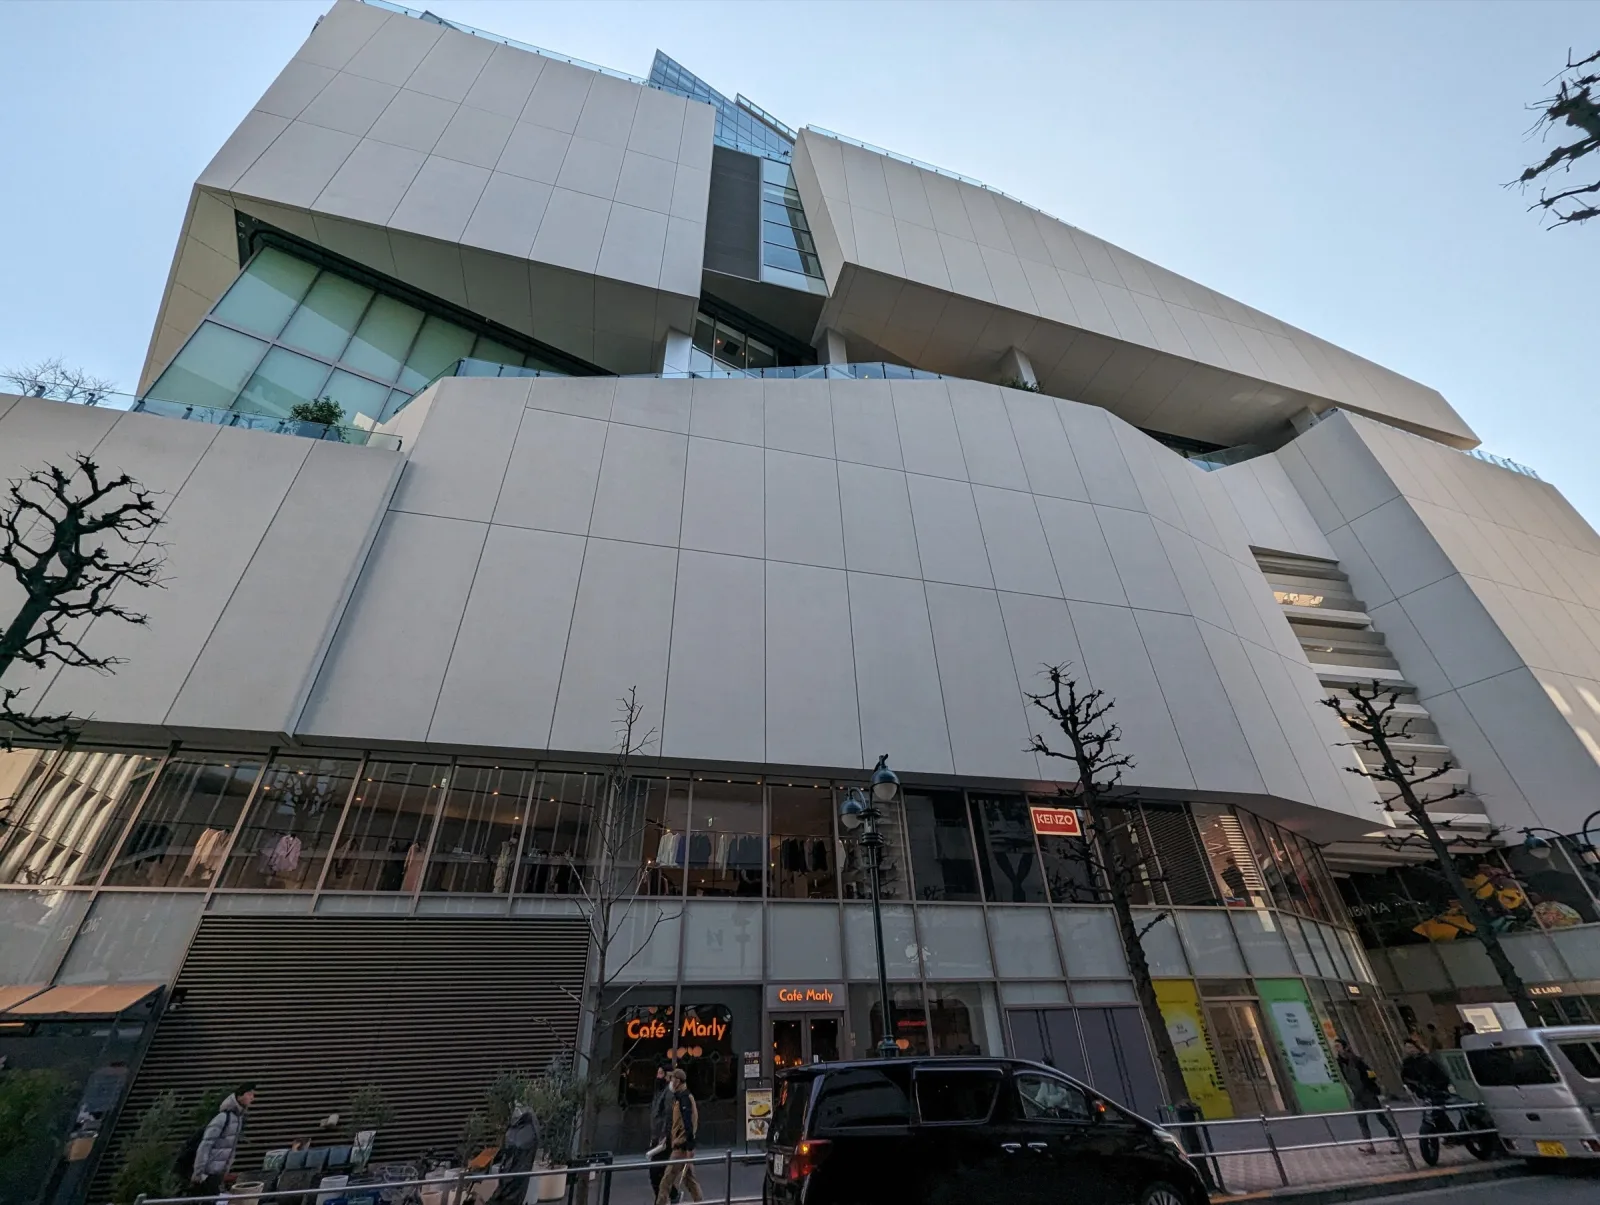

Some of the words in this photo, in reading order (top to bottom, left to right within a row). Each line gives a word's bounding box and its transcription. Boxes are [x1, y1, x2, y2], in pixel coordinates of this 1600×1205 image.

[1036, 813, 1073, 825] KENZO
[779, 988, 803, 1002] Café
[805, 988, 833, 1004] Marly
[1530, 987, 1542, 995] LE
[1541, 985, 1563, 994] LABO
[627, 1018, 666, 1039] Café
[681, 1017, 726, 1041] Marly
